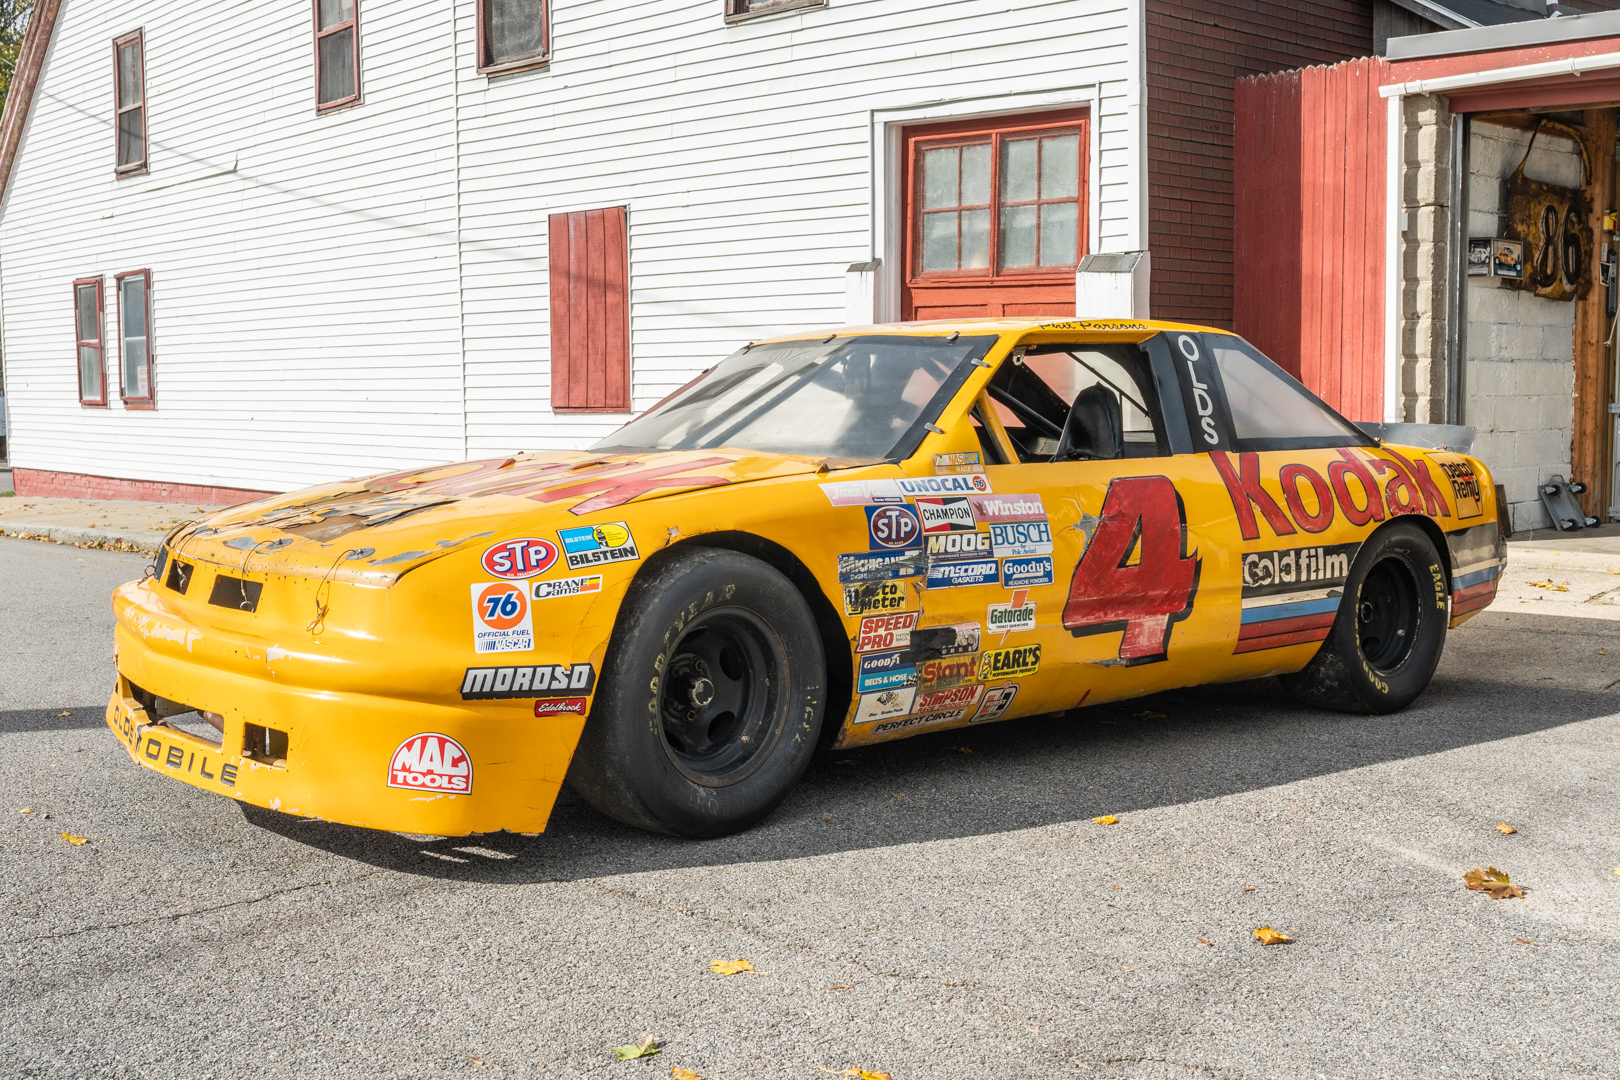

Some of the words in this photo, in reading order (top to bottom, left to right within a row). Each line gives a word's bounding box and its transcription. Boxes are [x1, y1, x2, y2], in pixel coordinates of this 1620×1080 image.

[1031, 320, 1076, 330] Phil
[1072, 320, 1148, 330] Parsons
[1177, 334, 1219, 445] OLDS
[948, 452, 979, 466] NASCAR
[1439, 462, 1475, 480] Delco
[900, 478, 975, 493] UNOCAL
[975, 480, 985, 488] 76
[1209, 448, 1451, 540] Kodak
[1452, 480, 1481, 503] Remy
[922, 507, 971, 521] CHAMPION
[984, 499, 1045, 516] Winston
[877, 510, 912, 540] STP
[991, 523, 1052, 546] BUSCH
[564, 533, 594, 543] BILSTEIN
[926, 533, 990, 554] MOOG
[492, 540, 549, 572] STP
[568, 546, 637, 567] BILSTEIN
[516, 568, 540, 577] TREATMENT
[952, 576, 984, 584] GASKETS
[1004, 560, 1052, 579] Goody's
[1062, 475, 1203, 667] 4
[1429, 563, 1446, 611] EAGLE
[483, 591, 519, 620] 76
[990, 607, 1034, 624] Gatorade
[477, 631, 510, 639] OFFICIAL
[512, 629, 531, 637] FUEL
[862, 614, 914, 635] SPEED
[496, 639, 532, 650] NASCAR
[860, 632, 894, 650] PRO
[924, 656, 976, 682] Stant
[992, 647, 1041, 671] EARL'S
[461, 665, 591, 693] MOROSO
[864, 677, 882, 687] BELTS
[882, 676, 889, 684] &
[889, 674, 907, 683] HOSE
[538, 702, 582, 713] Edelbrock
[918, 687, 978, 708] SIMPSON
[874, 714, 926, 733] PERFECT
[924, 708, 964, 722] CIRCLE
[113, 705, 240, 788] OLDSOBILE
[393, 737, 468, 776] MAC
[393, 770, 467, 790] TOOLS
